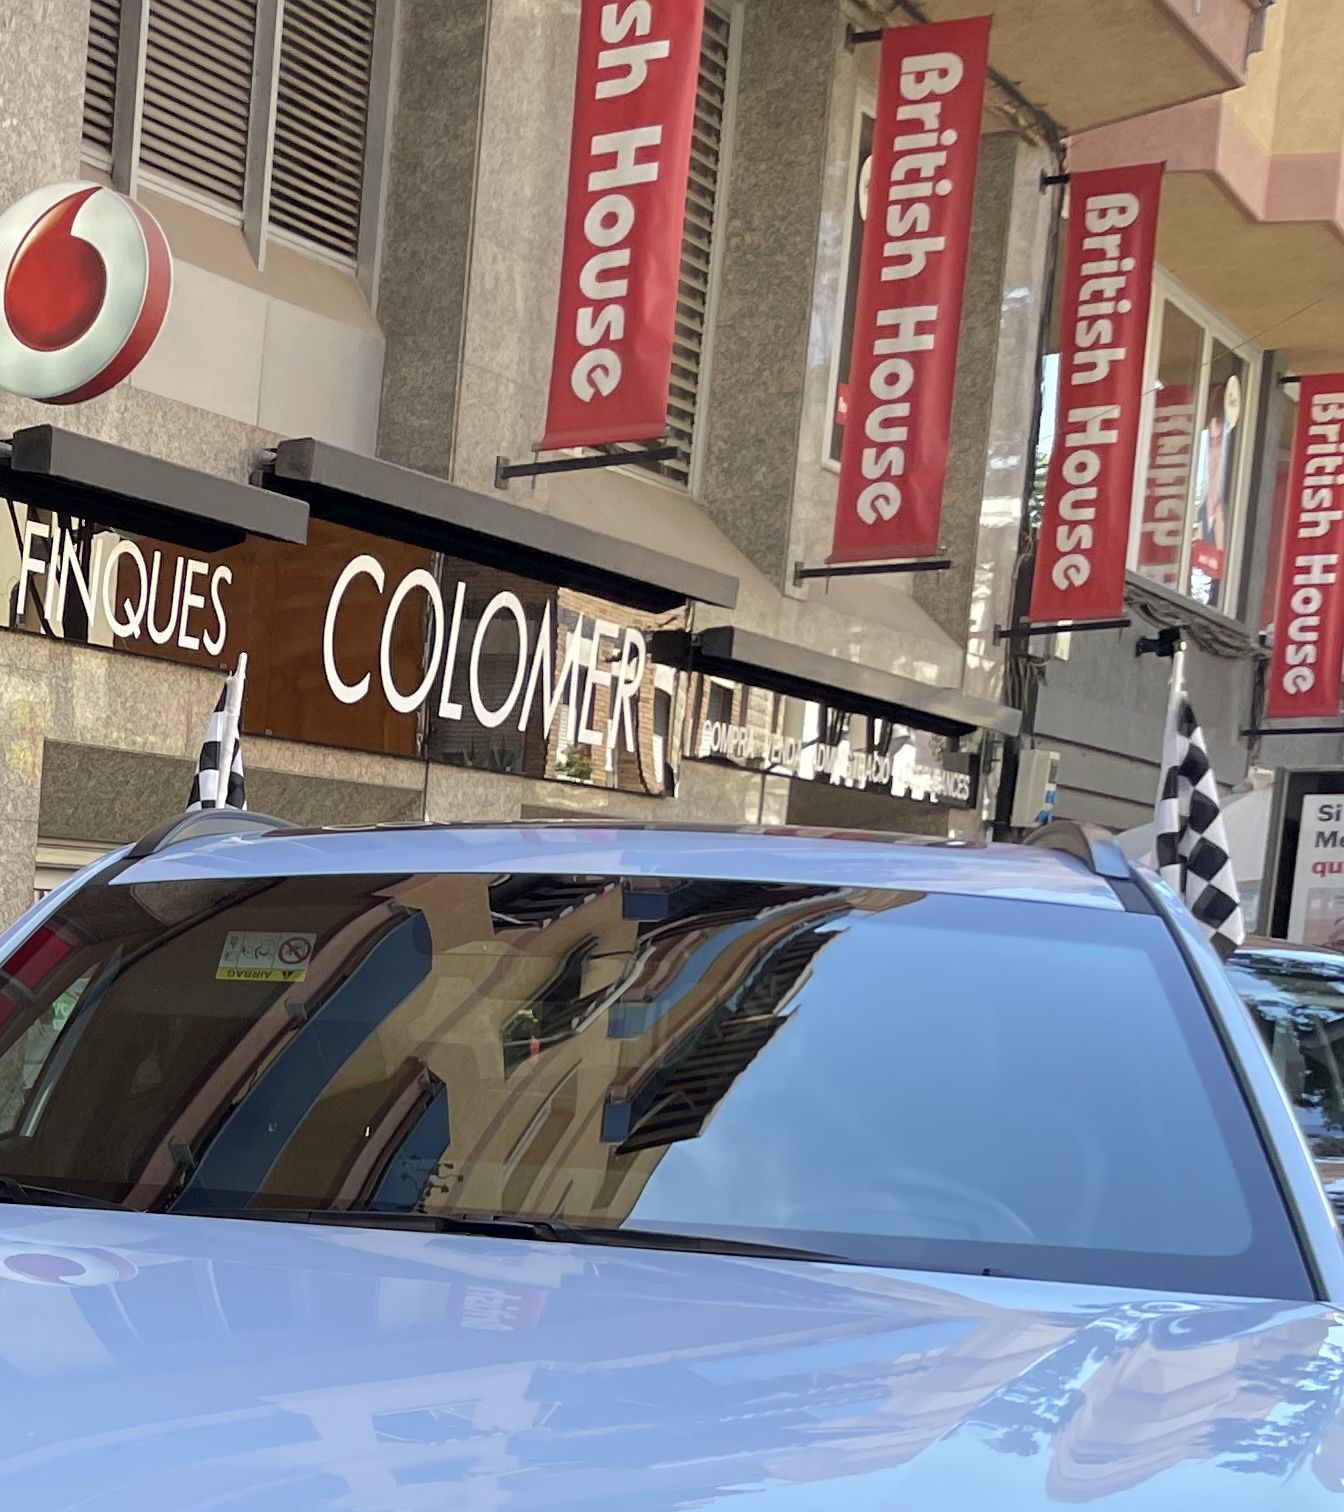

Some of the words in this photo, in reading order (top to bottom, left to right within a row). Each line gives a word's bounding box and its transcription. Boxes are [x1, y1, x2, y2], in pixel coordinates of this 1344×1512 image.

[881, 53, 963, 282] British
[572, 125, 662, 402] House
[1072, 194, 1138, 385] British
[857, 305, 938, 524] House
[1052, 405, 1120, 590] House
[1299, 393, 1344, 538] British
[15, 520, 233, 656] FINQUES
[323, 554, 647, 753] COLOMER
[1284, 554, 1339, 694] House
[1312, 861, 1344, 878] qu
[1317, 804, 1343, 822] Si
[226, 970, 272, 979] AIRBAG
